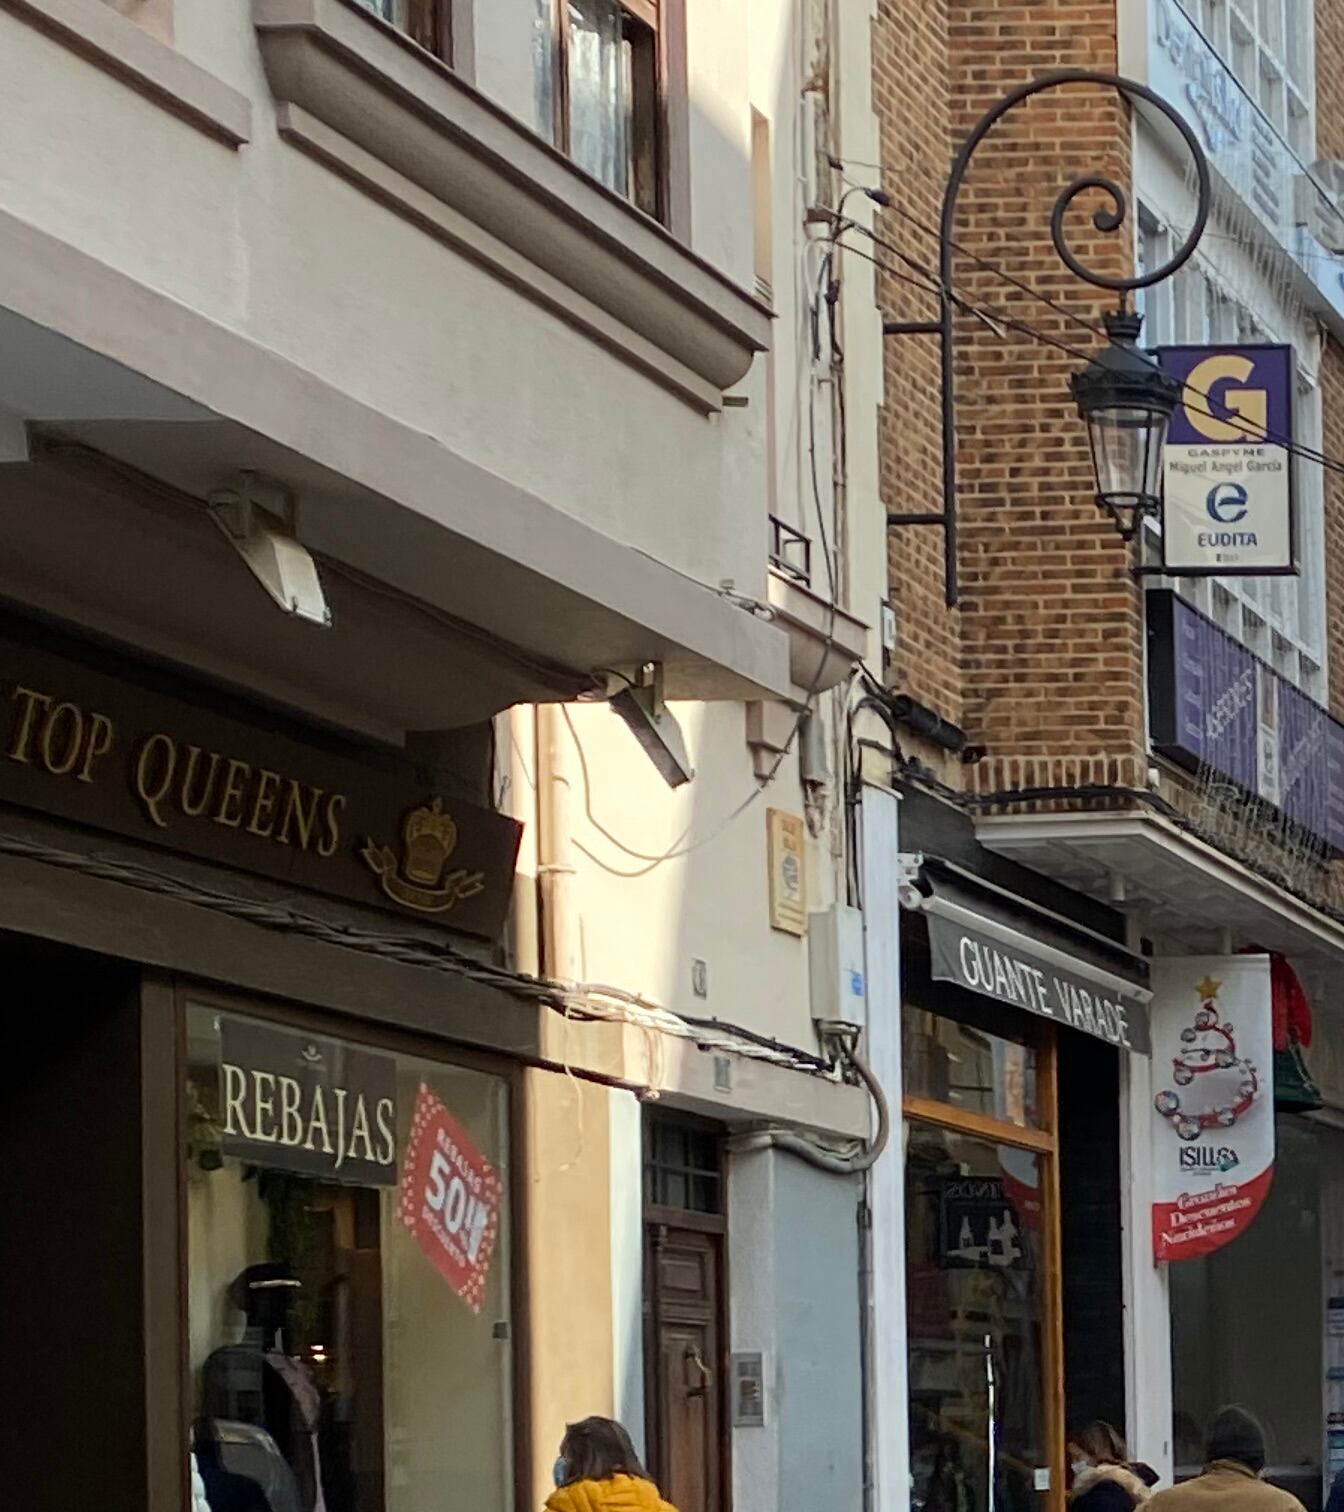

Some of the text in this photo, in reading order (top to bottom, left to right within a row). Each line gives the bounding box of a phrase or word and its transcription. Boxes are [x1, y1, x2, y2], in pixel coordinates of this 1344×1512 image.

[1182, 353, 1268, 442] G
[1196, 532, 1258, 548] EUDITA
[9, 684, 347, 858] TOP QUEENS
[959, 935, 1053, 1015] GUANTE
[222, 1063, 395, 1169] REBAJAS
